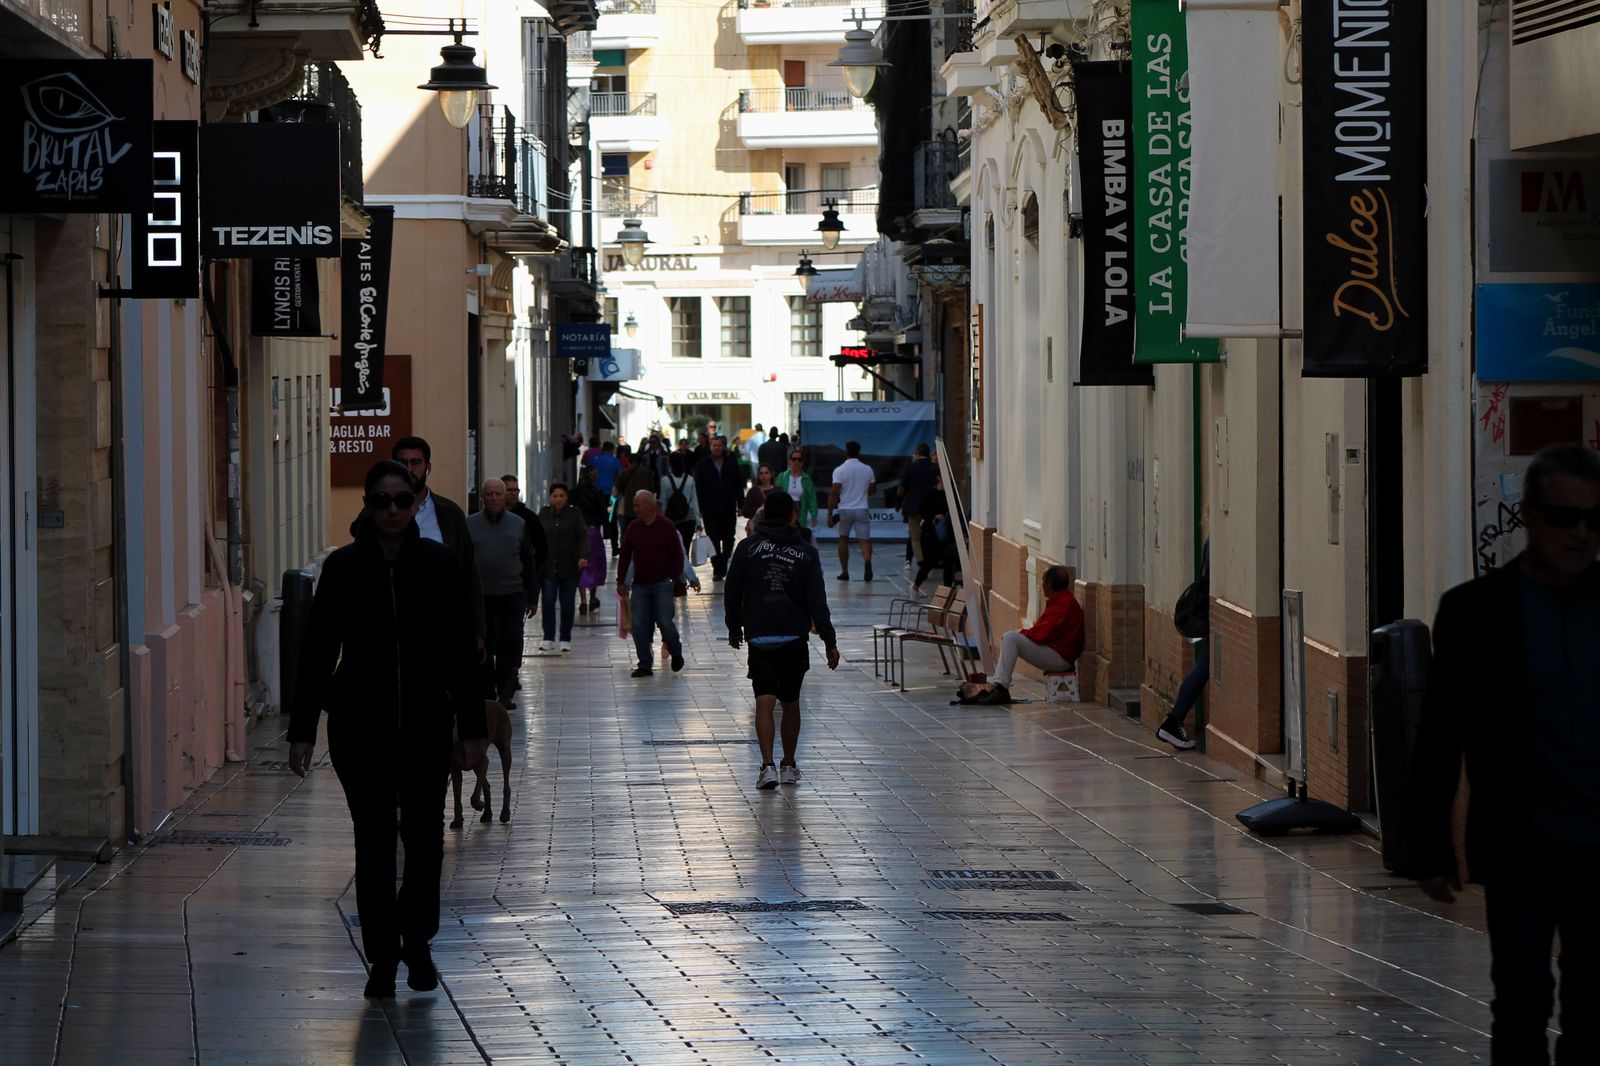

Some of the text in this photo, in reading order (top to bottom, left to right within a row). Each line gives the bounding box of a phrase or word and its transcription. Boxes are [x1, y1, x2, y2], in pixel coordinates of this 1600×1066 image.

[22, 120, 133, 174] BRUTAL
[35, 167, 104, 200] ZAPAS
[1147, 33, 1173, 315] LA CASA DE LAS
[1102, 119, 1129, 327] BIMBA Y LOLA
[1326, 187, 1396, 332] Dulce
[274, 275, 291, 329] LYNCIS
[561, 331, 606, 342] NOTARÍA
[368, 425, 391, 438] BAR
[845, 406, 901, 414] encuentro
[339, 440, 373, 453] RESTO
